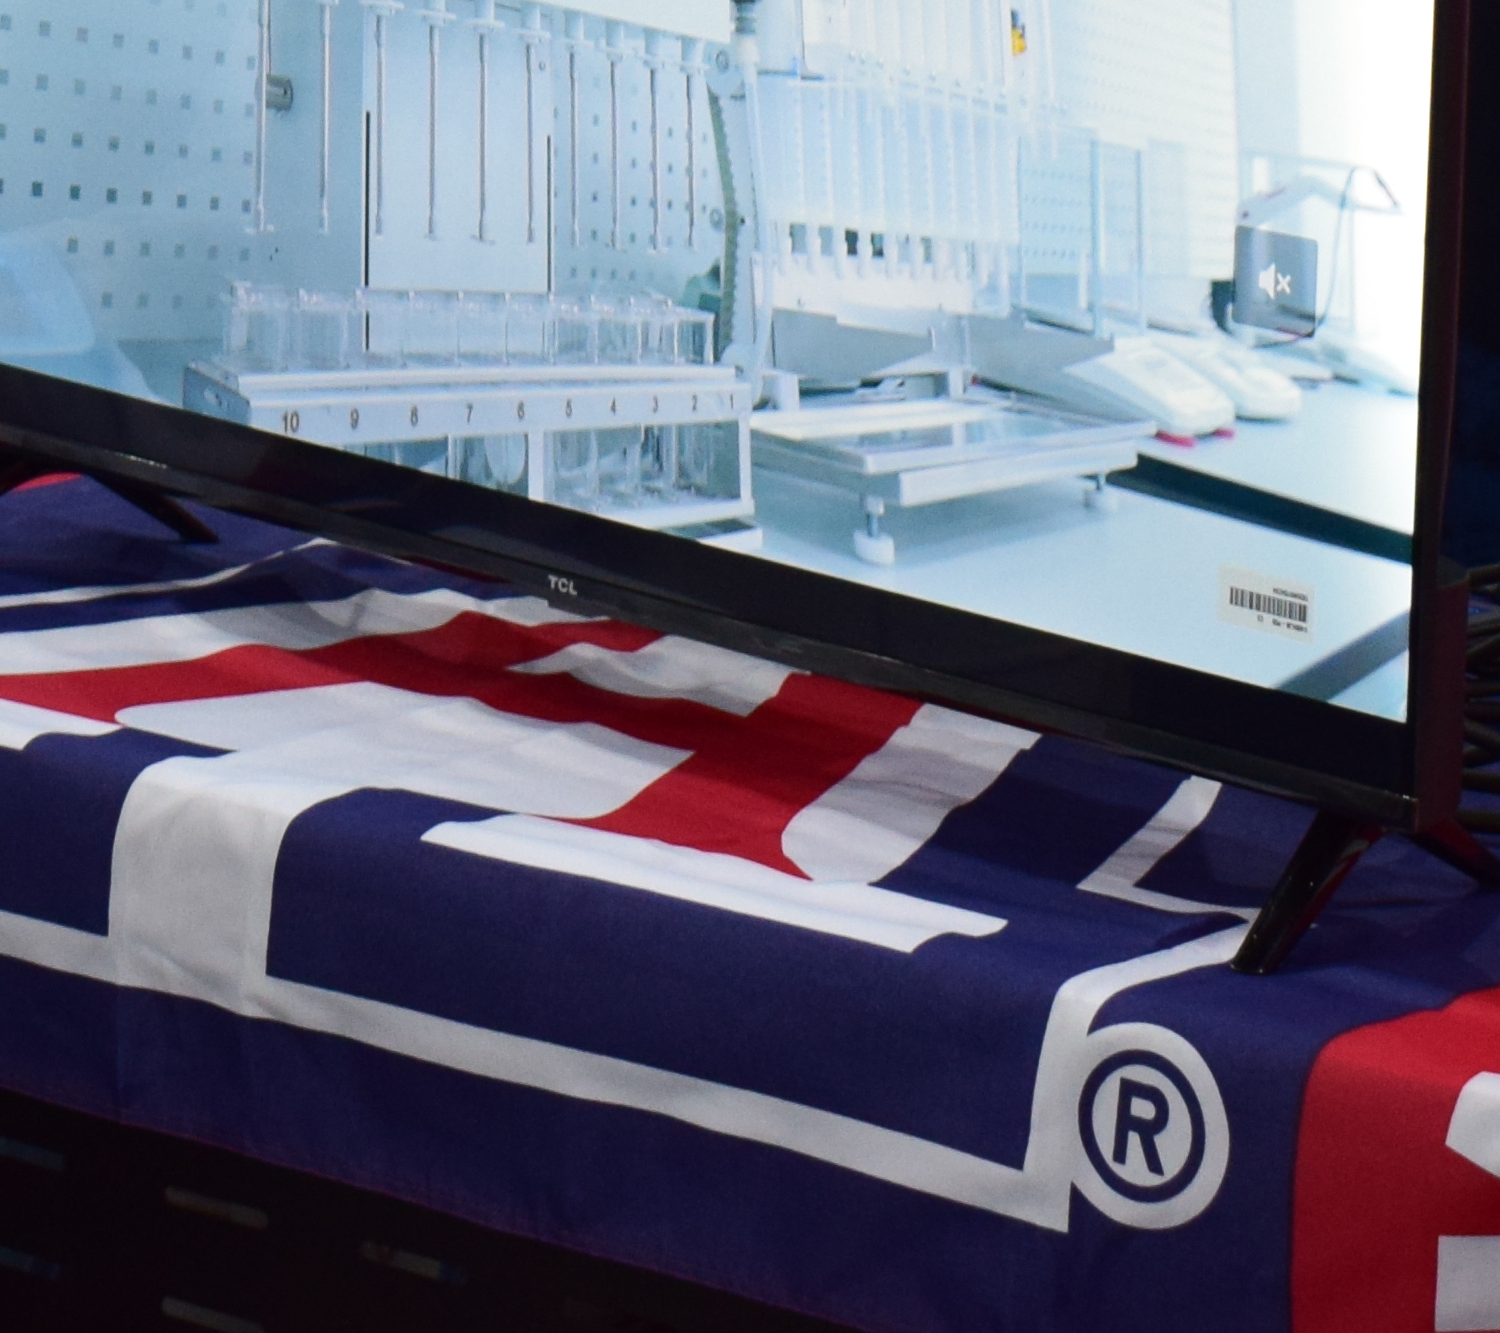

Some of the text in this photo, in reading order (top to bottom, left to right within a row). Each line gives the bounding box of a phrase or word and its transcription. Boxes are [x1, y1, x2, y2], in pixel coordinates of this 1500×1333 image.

[282, 408, 300, 434] 10
[465, 401, 474, 425] 7
[547, 573, 578, 596] TCL
